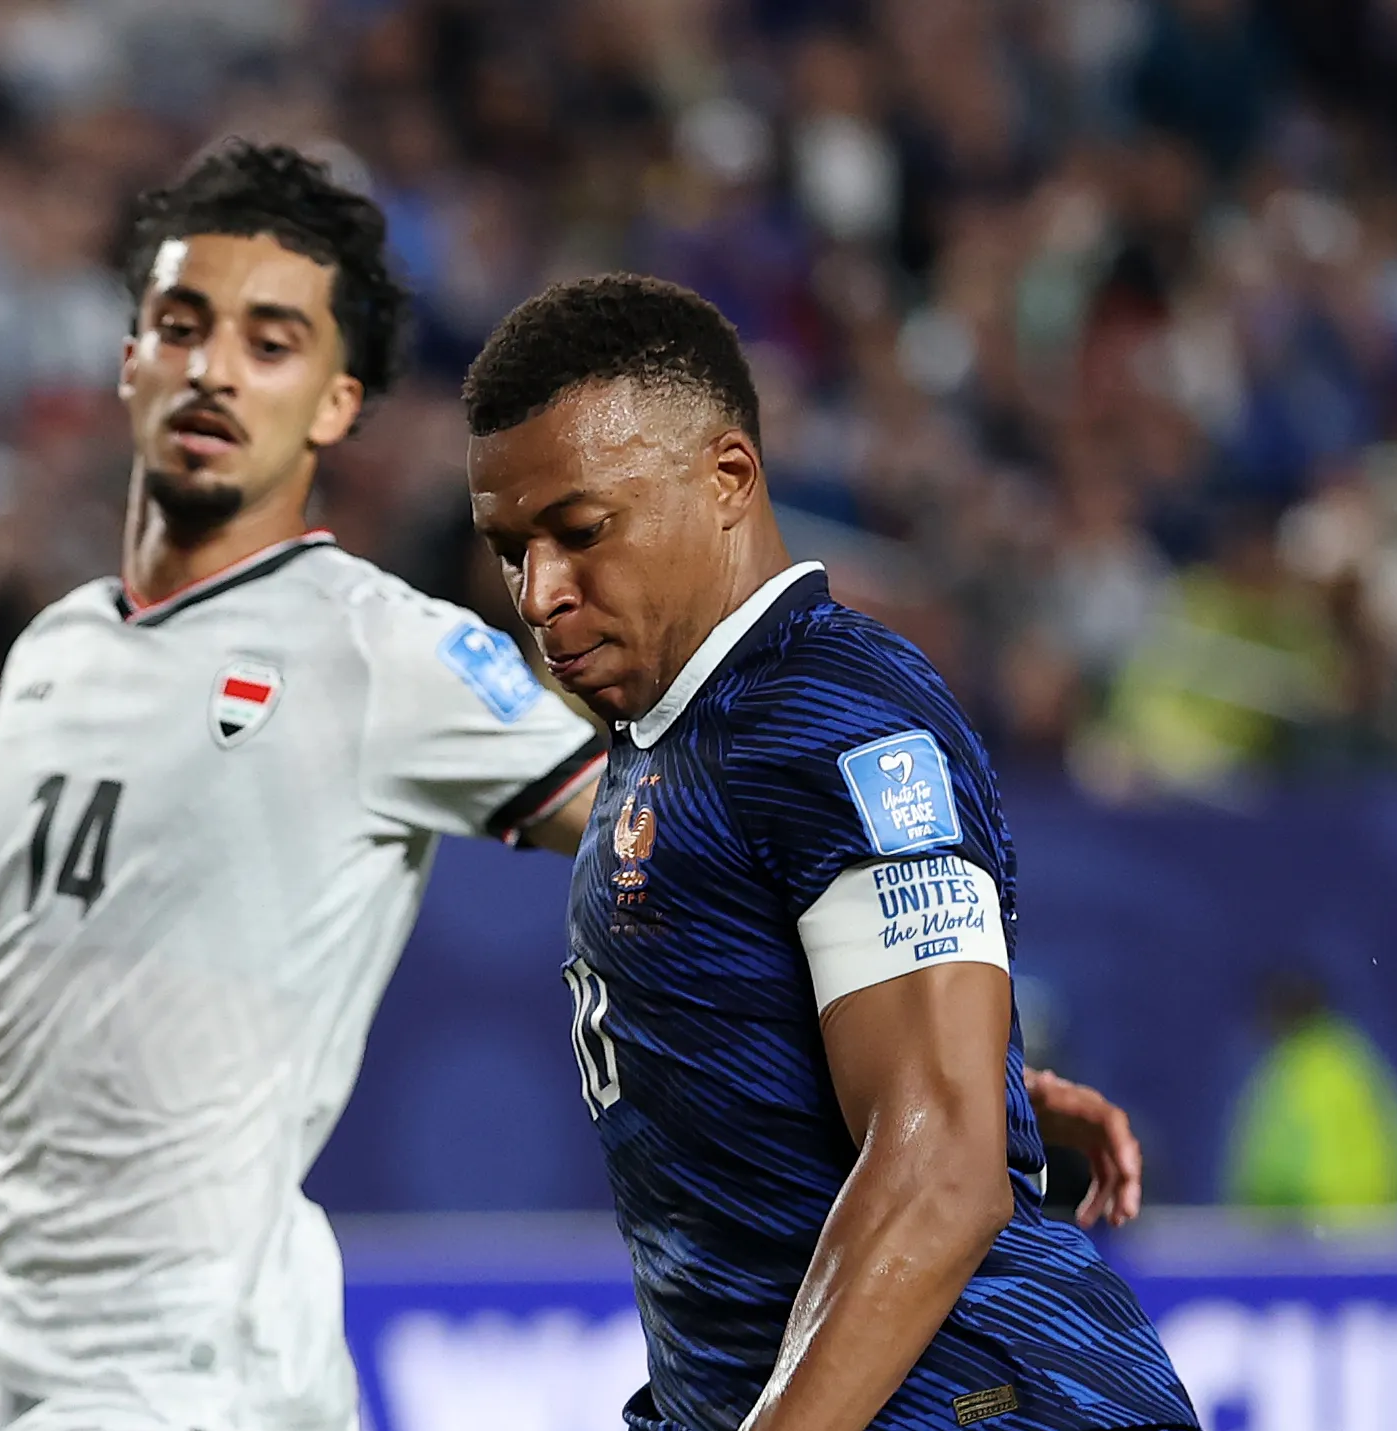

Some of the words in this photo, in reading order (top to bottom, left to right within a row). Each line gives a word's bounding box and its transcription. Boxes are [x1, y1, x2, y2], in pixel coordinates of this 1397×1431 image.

[881, 784, 914, 811] Unite
[890, 801, 937, 830] PEACE
[907, 824, 934, 840] FIFA
[28, 773, 125, 920] 14
[872, 856, 973, 890] FOOTBALL
[877, 878, 980, 920] UNITES
[878, 921, 918, 949] the
[921, 908, 986, 937] World
[916, 938, 957, 960] FIFA
[562, 956, 621, 1122] 10
